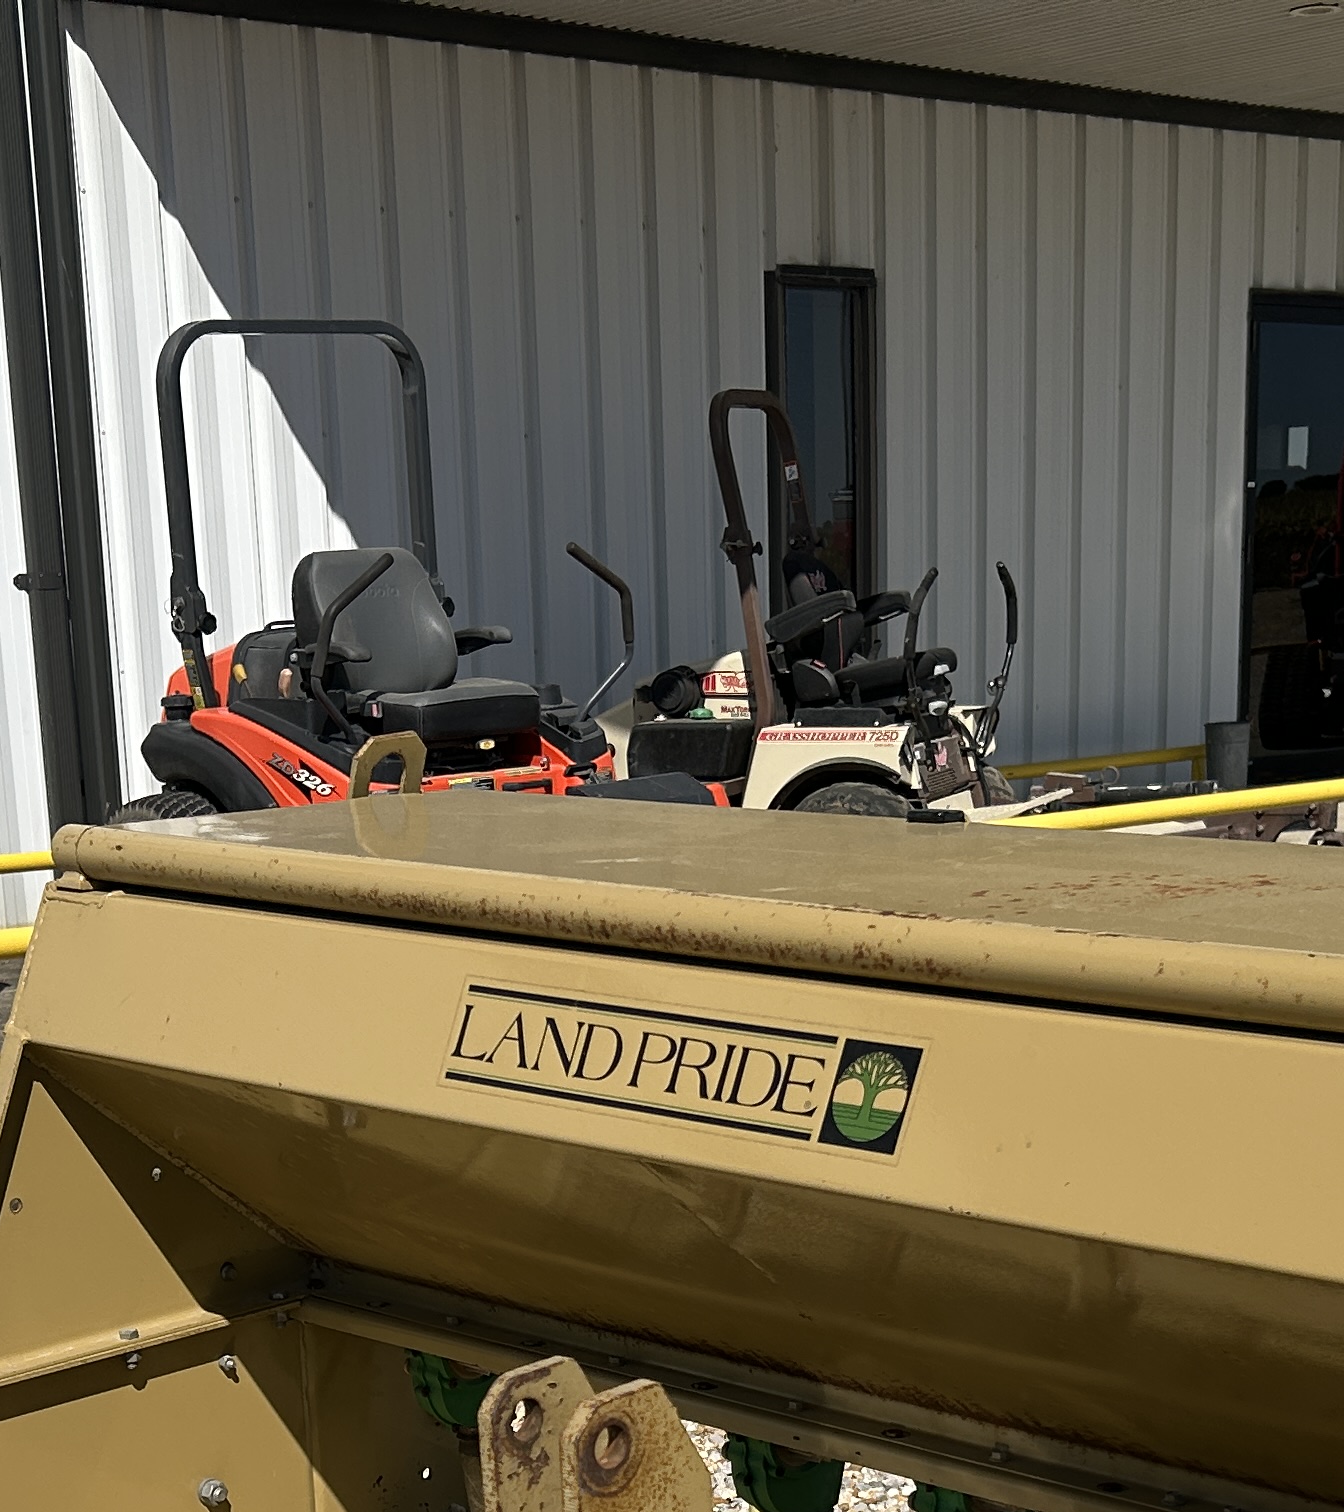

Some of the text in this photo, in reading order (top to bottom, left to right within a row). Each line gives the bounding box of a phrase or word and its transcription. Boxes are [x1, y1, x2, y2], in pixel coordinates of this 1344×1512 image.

[869, 731, 899, 741] 725D
[451, 1003, 825, 1118] LAND PRIDE
